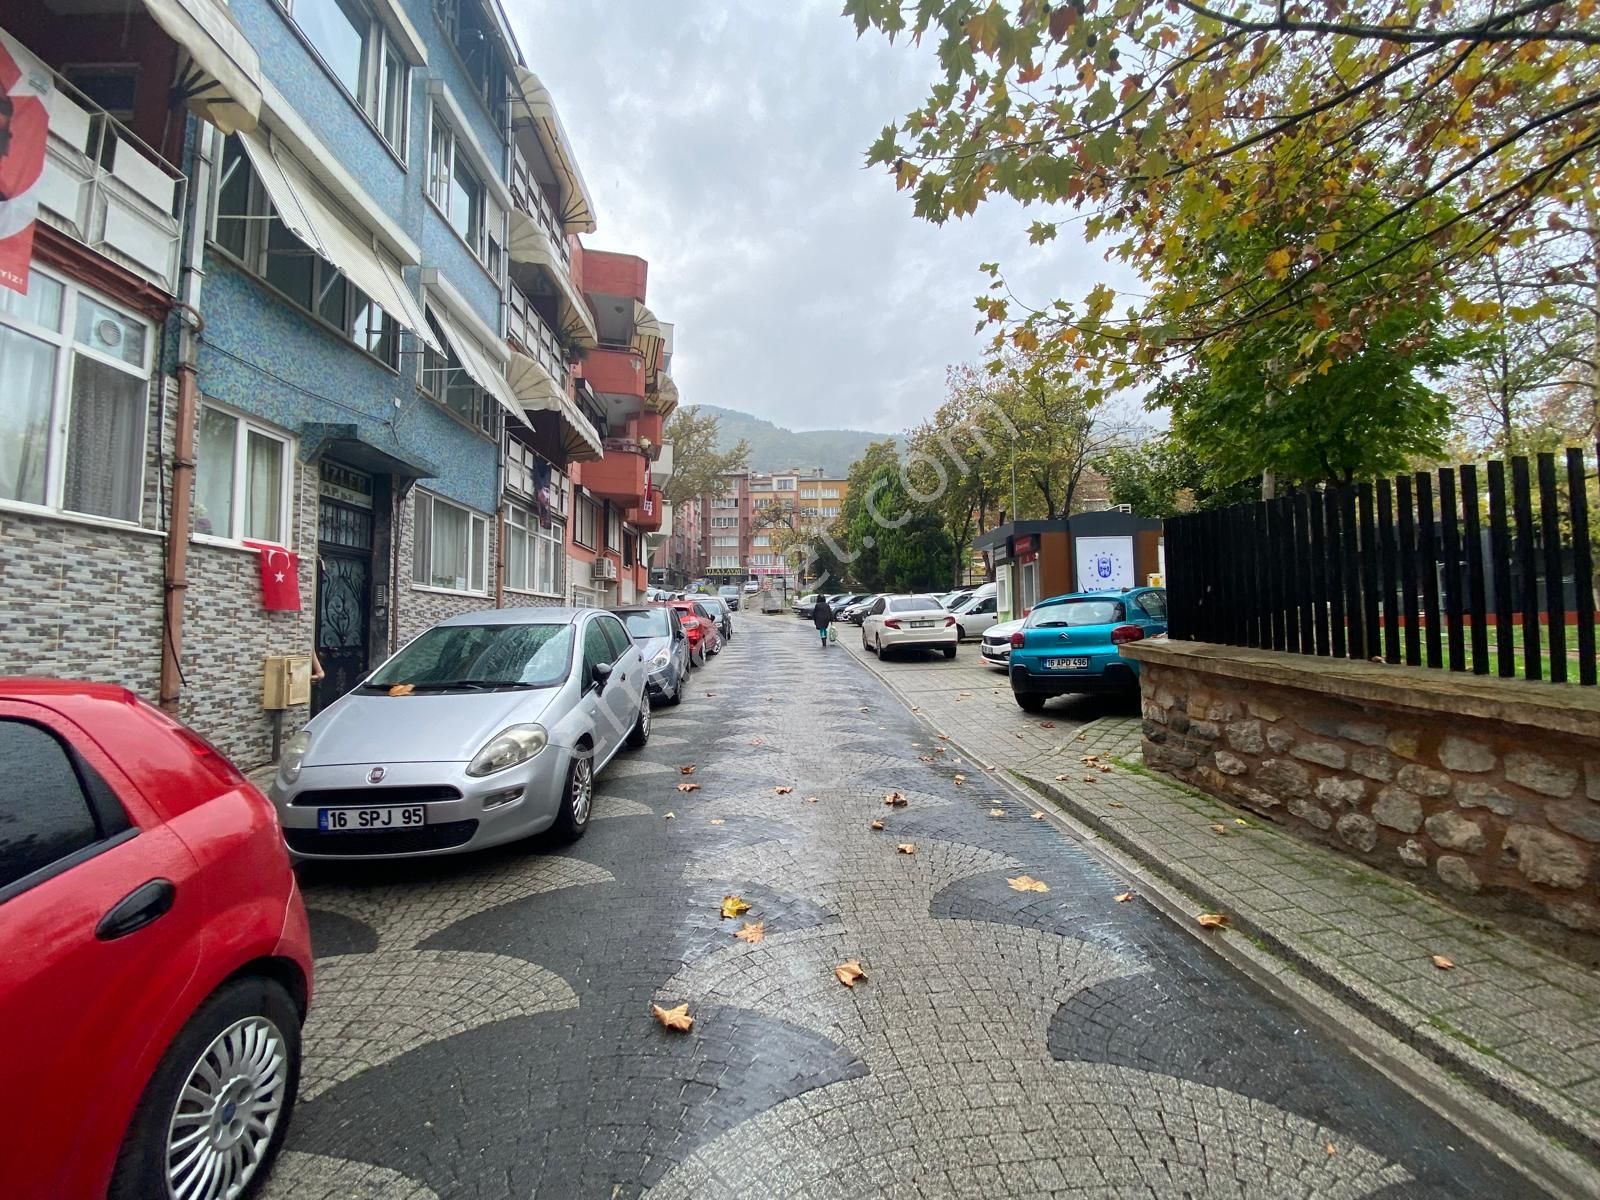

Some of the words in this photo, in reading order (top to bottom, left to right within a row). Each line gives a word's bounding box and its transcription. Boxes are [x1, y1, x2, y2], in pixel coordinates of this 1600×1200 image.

[1047, 658, 1055, 667] 16
[1073, 658, 1087, 666] 496
[330, 811, 348, 828] 16
[358, 809, 392, 827] SPJ
[402, 808, 422, 825] 95
